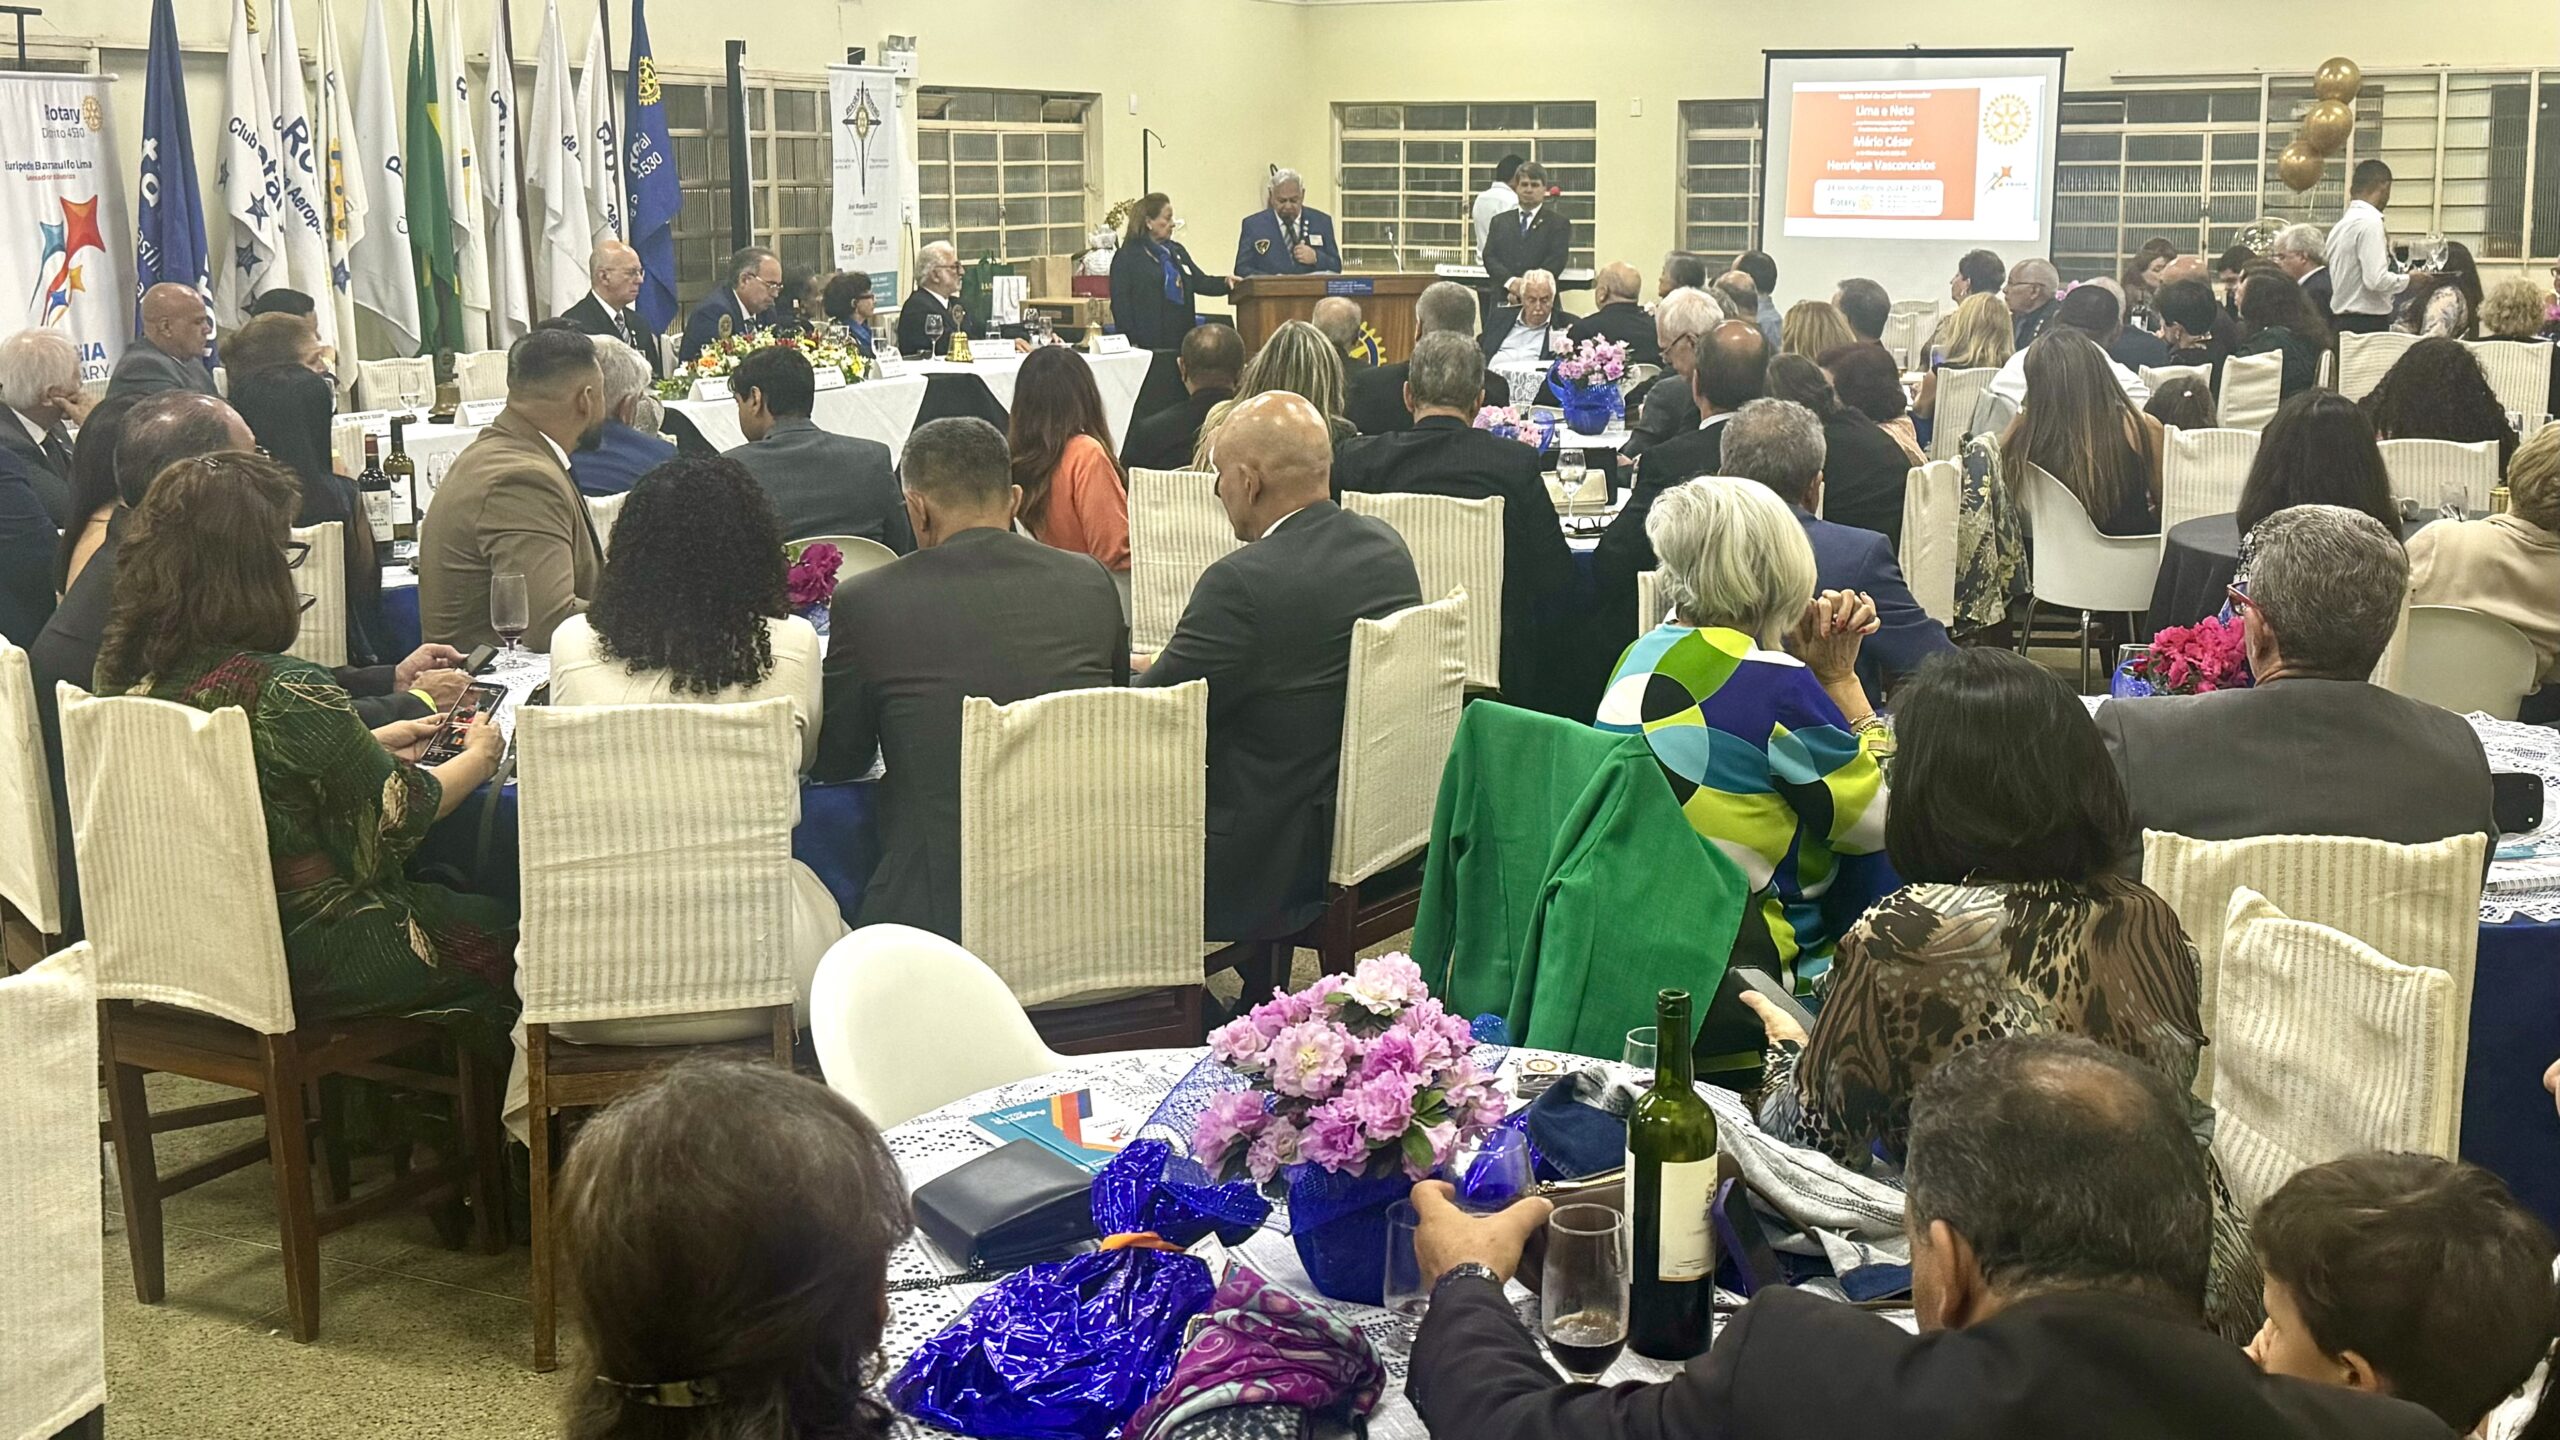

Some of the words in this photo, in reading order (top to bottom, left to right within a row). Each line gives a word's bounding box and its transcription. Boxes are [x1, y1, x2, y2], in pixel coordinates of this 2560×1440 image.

[1856, 105, 1880, 116] Lima
[228, 117, 258, 149] Club
[76, 160, 92, 169] Lima
[1826, 160, 1873, 173] Henrique
[1874, 159, 1936, 171] Vasconcelos
